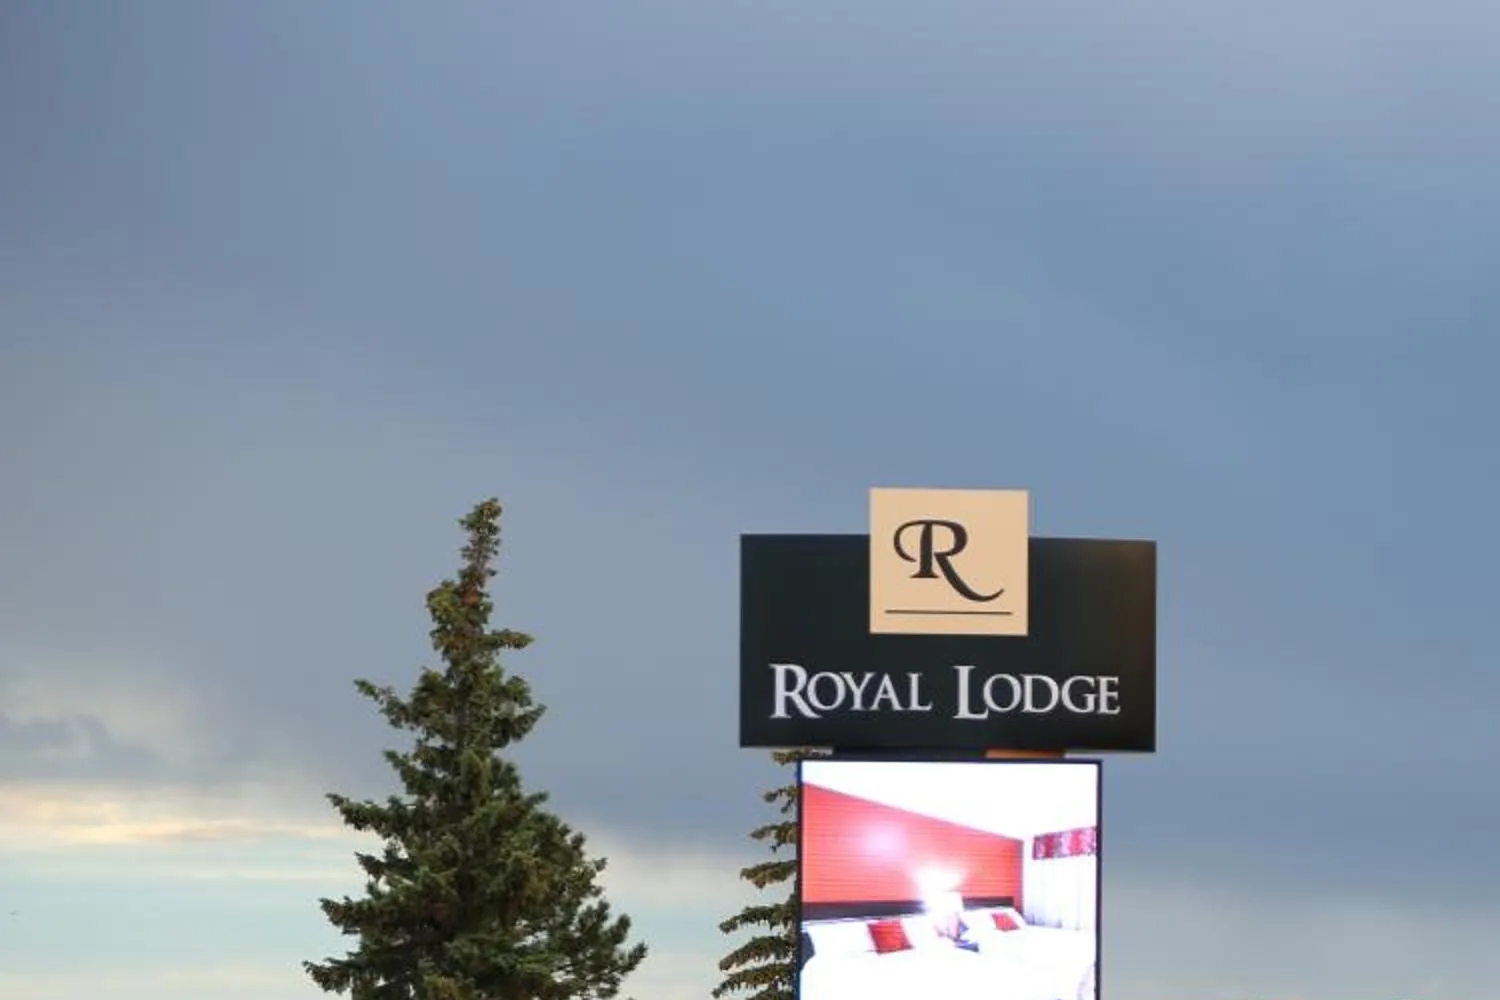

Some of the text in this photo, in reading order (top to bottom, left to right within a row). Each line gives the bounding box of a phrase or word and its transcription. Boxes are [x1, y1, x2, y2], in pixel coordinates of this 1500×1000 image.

[893, 519, 1005, 602] R
[768, 663, 1121, 719] ROYAL LODGE
